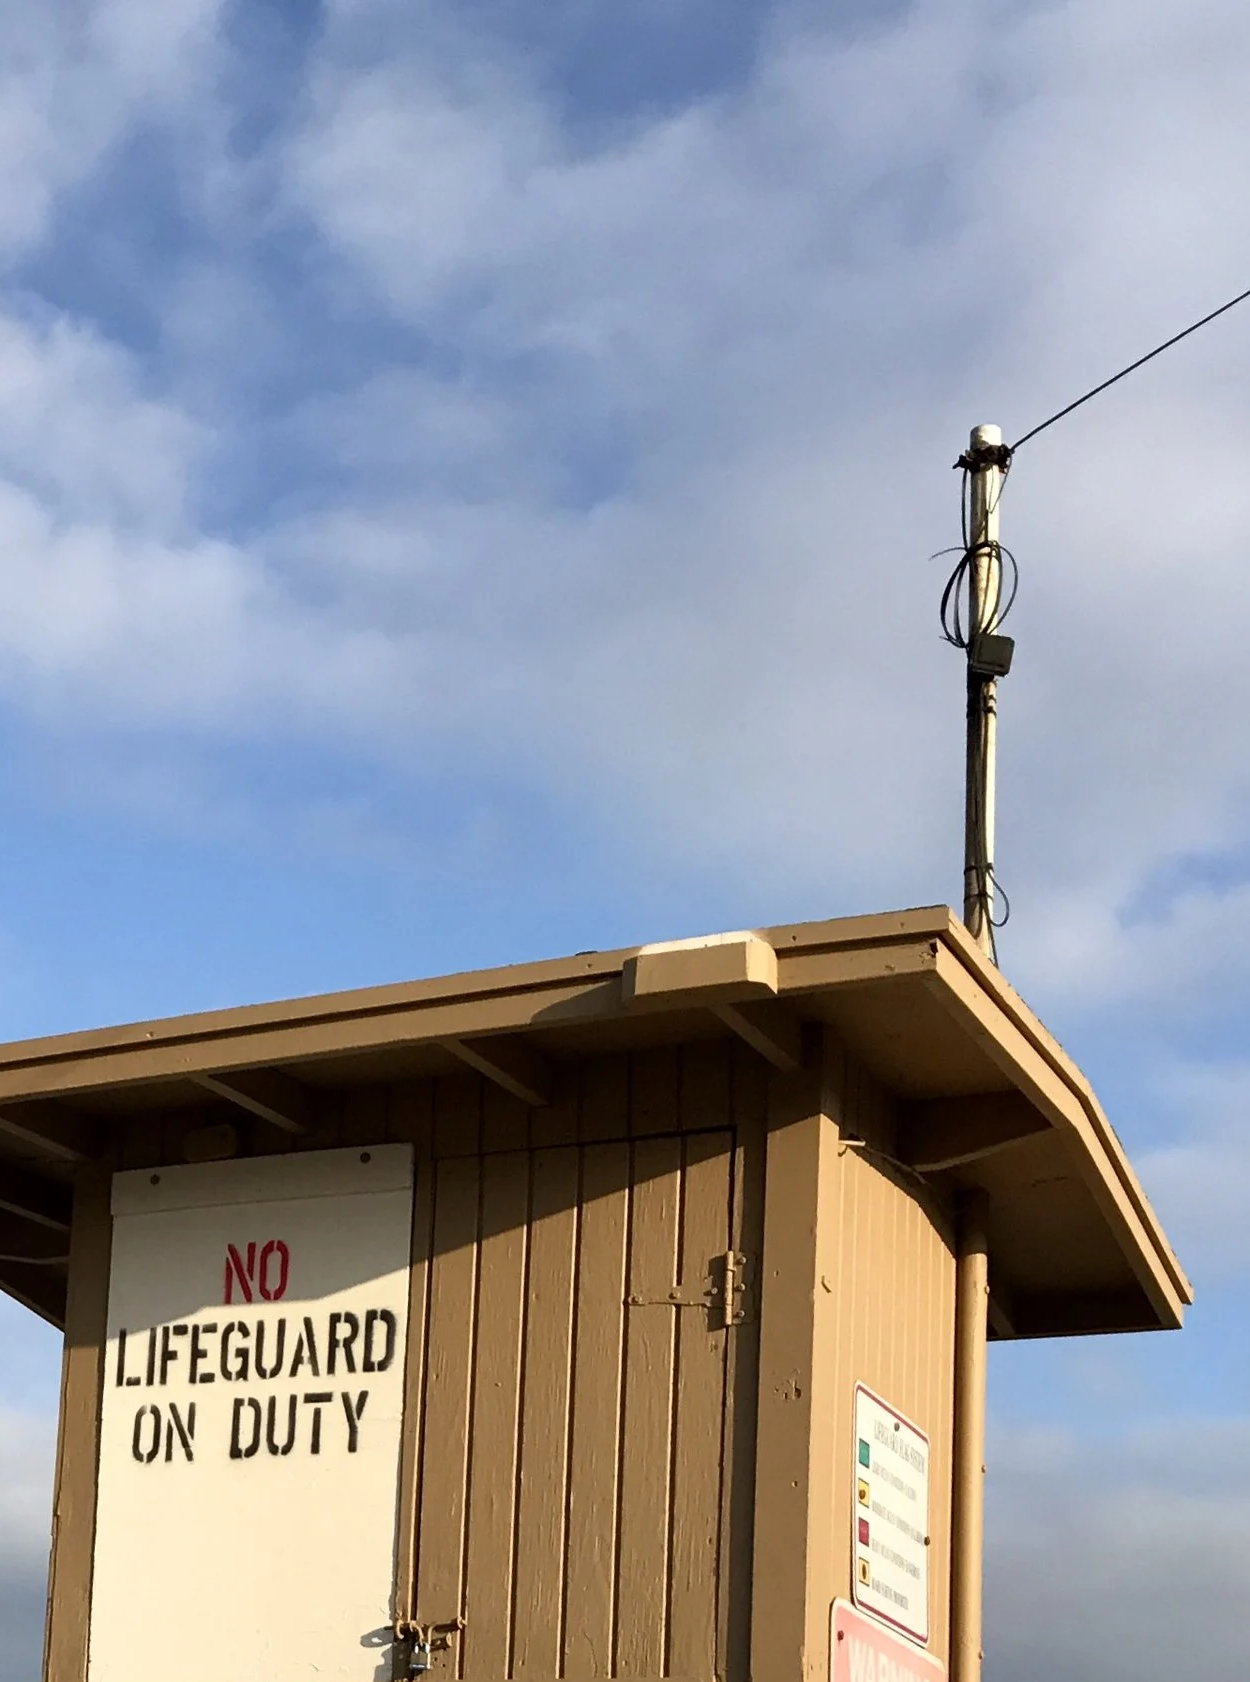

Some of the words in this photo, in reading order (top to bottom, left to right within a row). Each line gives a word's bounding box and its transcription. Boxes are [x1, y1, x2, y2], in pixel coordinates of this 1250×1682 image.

[223, 1239, 290, 1305] NO
[116, 1308, 397, 1388] LIFEGUARD
[131, 1401, 196, 1464] ON
[229, 1389, 369, 1460] DUTY
